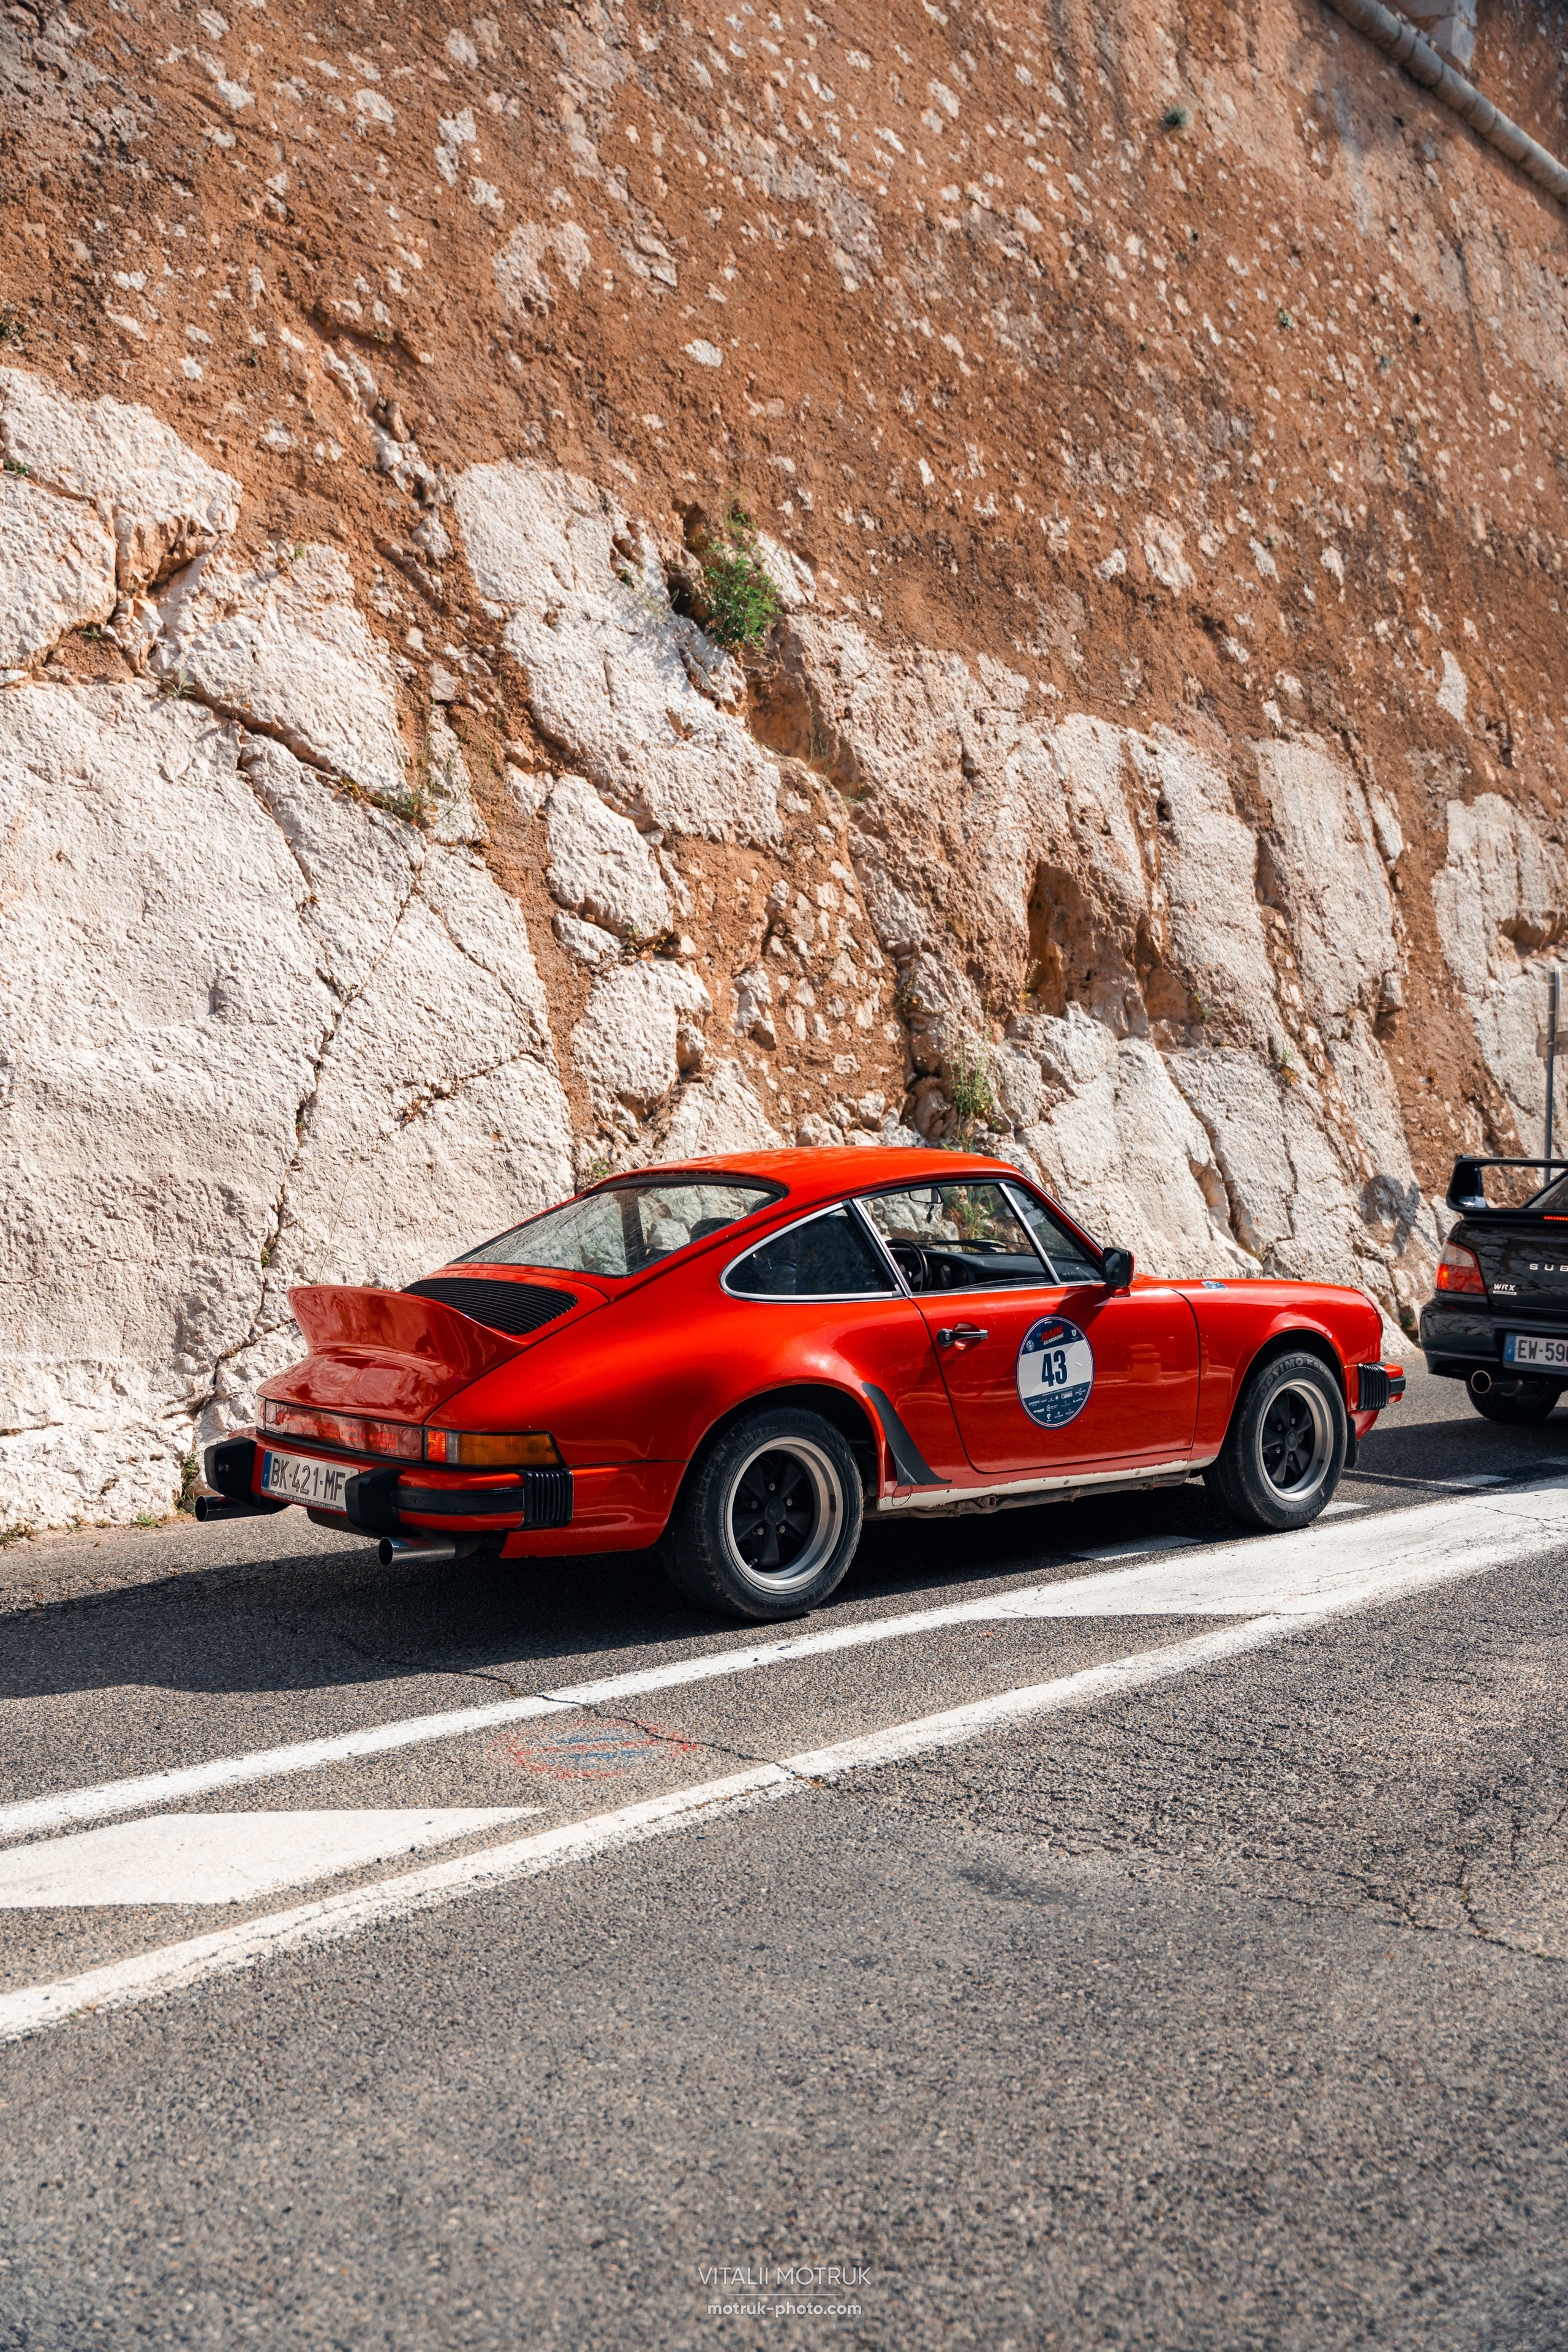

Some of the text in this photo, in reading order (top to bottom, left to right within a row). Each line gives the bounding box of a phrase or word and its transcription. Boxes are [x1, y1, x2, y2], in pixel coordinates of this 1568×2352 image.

[1493, 1283, 1516, 1292] WRX
[1041, 1324, 1065, 1342] RADE
[1043, 1333, 1065, 1346] CLASSIQUE
[1517, 1340, 1568, 1362] EW-59
[1041, 1349, 1068, 1387] 43
[1260, 1357, 1303, 1398] OPTIMO
[277, 1412, 398, 1449] PORSCHE
[271, 1458, 345, 1501] BK-421-MF
[284, 1494, 337, 1510] www.groupe-michel.com
